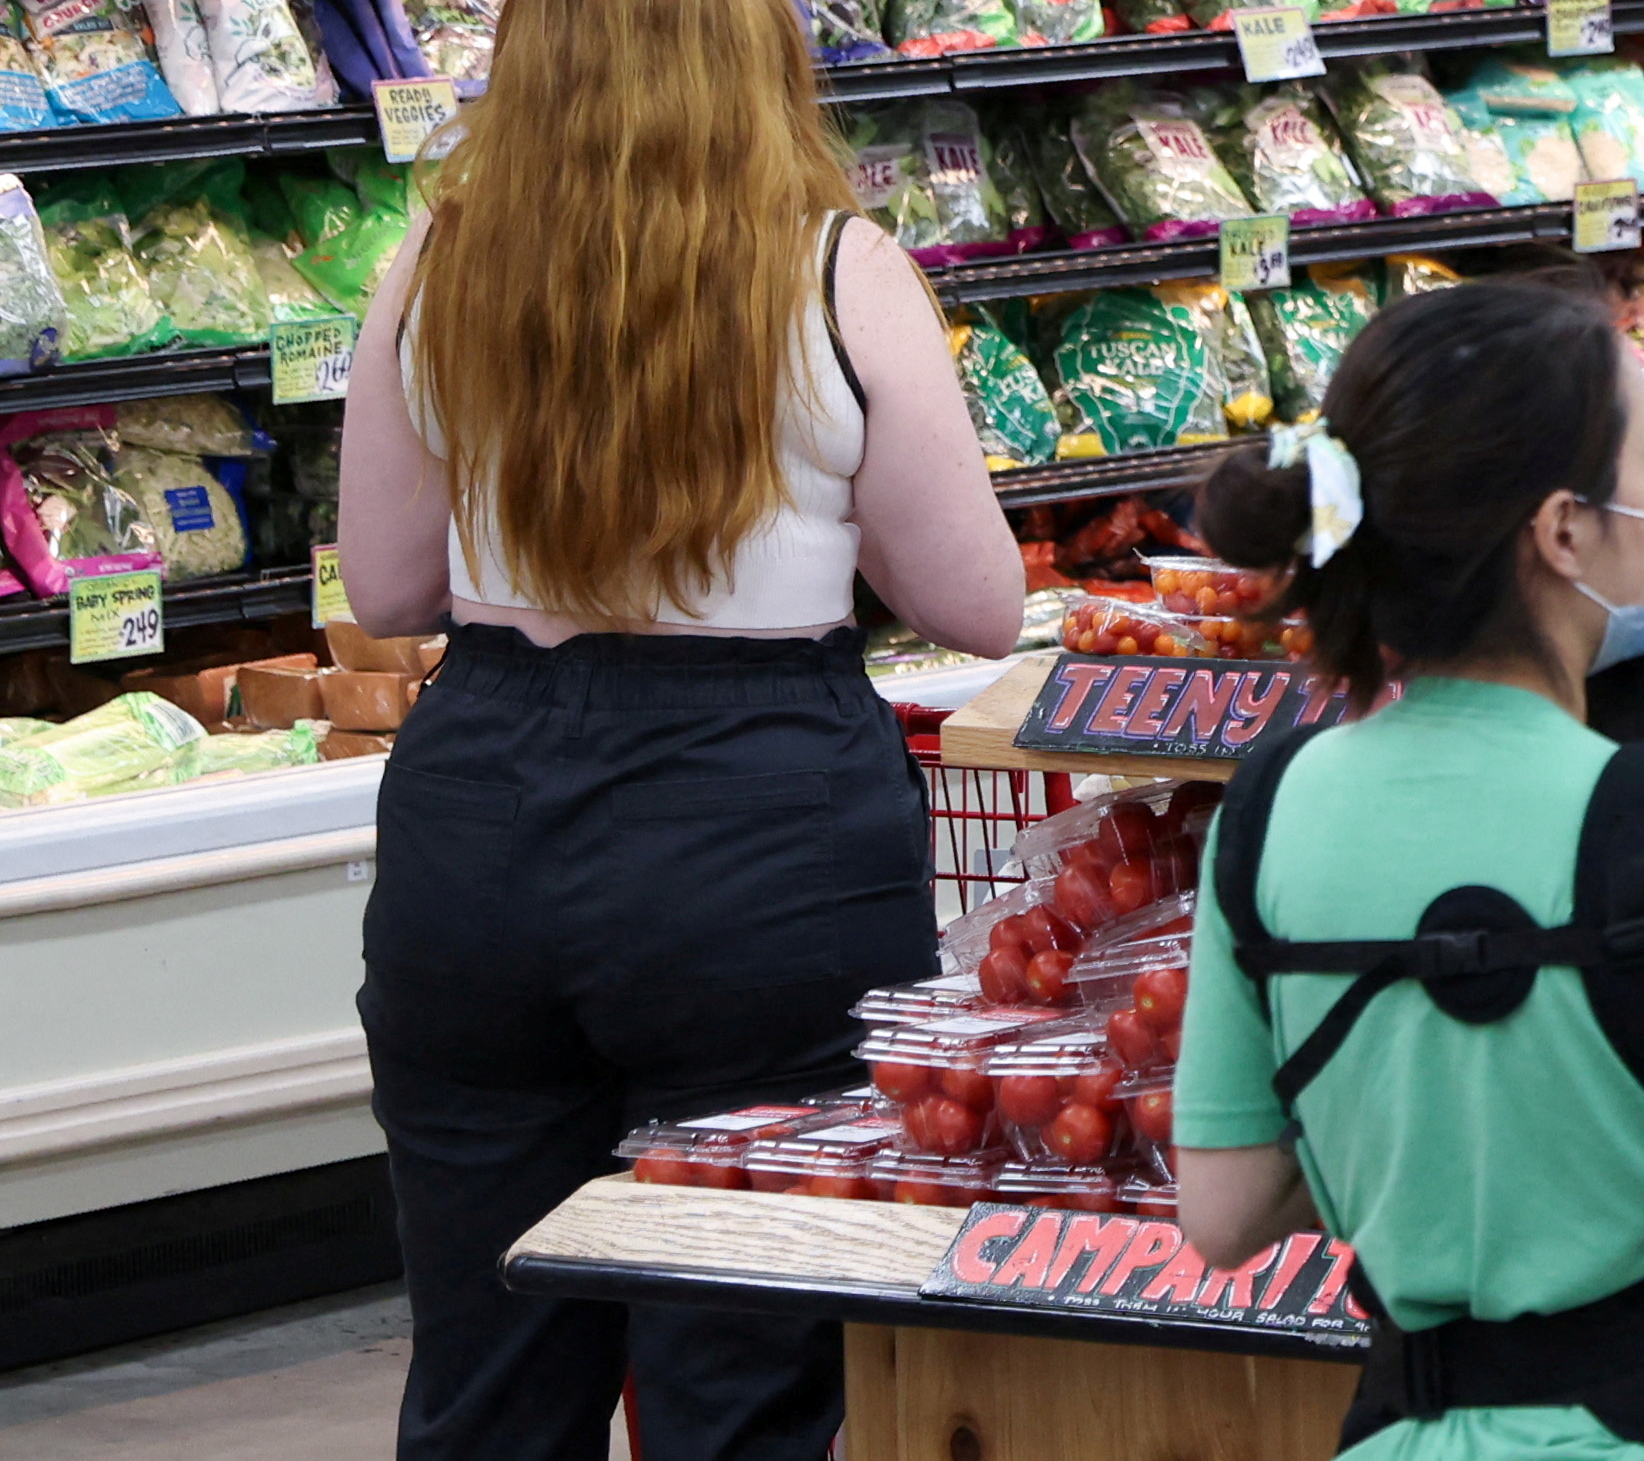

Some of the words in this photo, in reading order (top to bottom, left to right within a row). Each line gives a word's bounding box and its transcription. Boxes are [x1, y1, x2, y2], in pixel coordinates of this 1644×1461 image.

[1241, 18, 1284, 38] KALE
[385, 104, 445, 122] VEGGIES
[936, 140, 980, 176] KALE
[857, 158, 896, 189] ALE
[275, 326, 341, 351] CHOPPED
[281, 342, 341, 367] ROMAINE
[1090, 341, 1179, 363] TUSCAN
[76, 594, 106, 611] BABY
[111, 585, 155, 605] SPRING
[91, 607, 121, 623] MIX
[1046, 662, 1292, 747] TEENY
